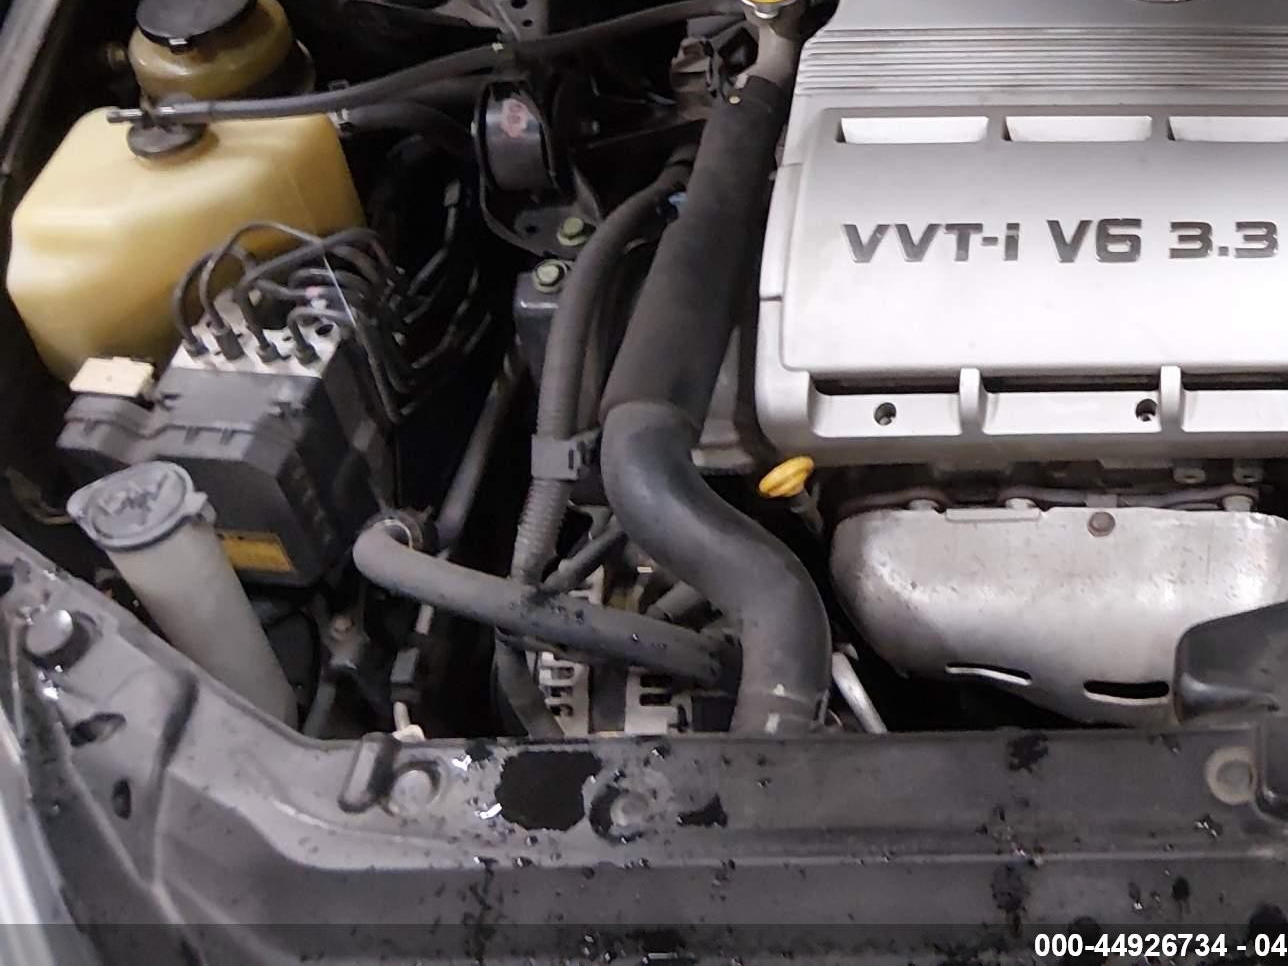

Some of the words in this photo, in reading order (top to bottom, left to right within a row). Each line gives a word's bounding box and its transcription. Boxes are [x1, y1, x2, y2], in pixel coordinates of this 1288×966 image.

[843, 222, 1020, 263] VVT-i
[1046, 218, 1142, 263] V6
[1169, 220, 1279, 259] 3.3
